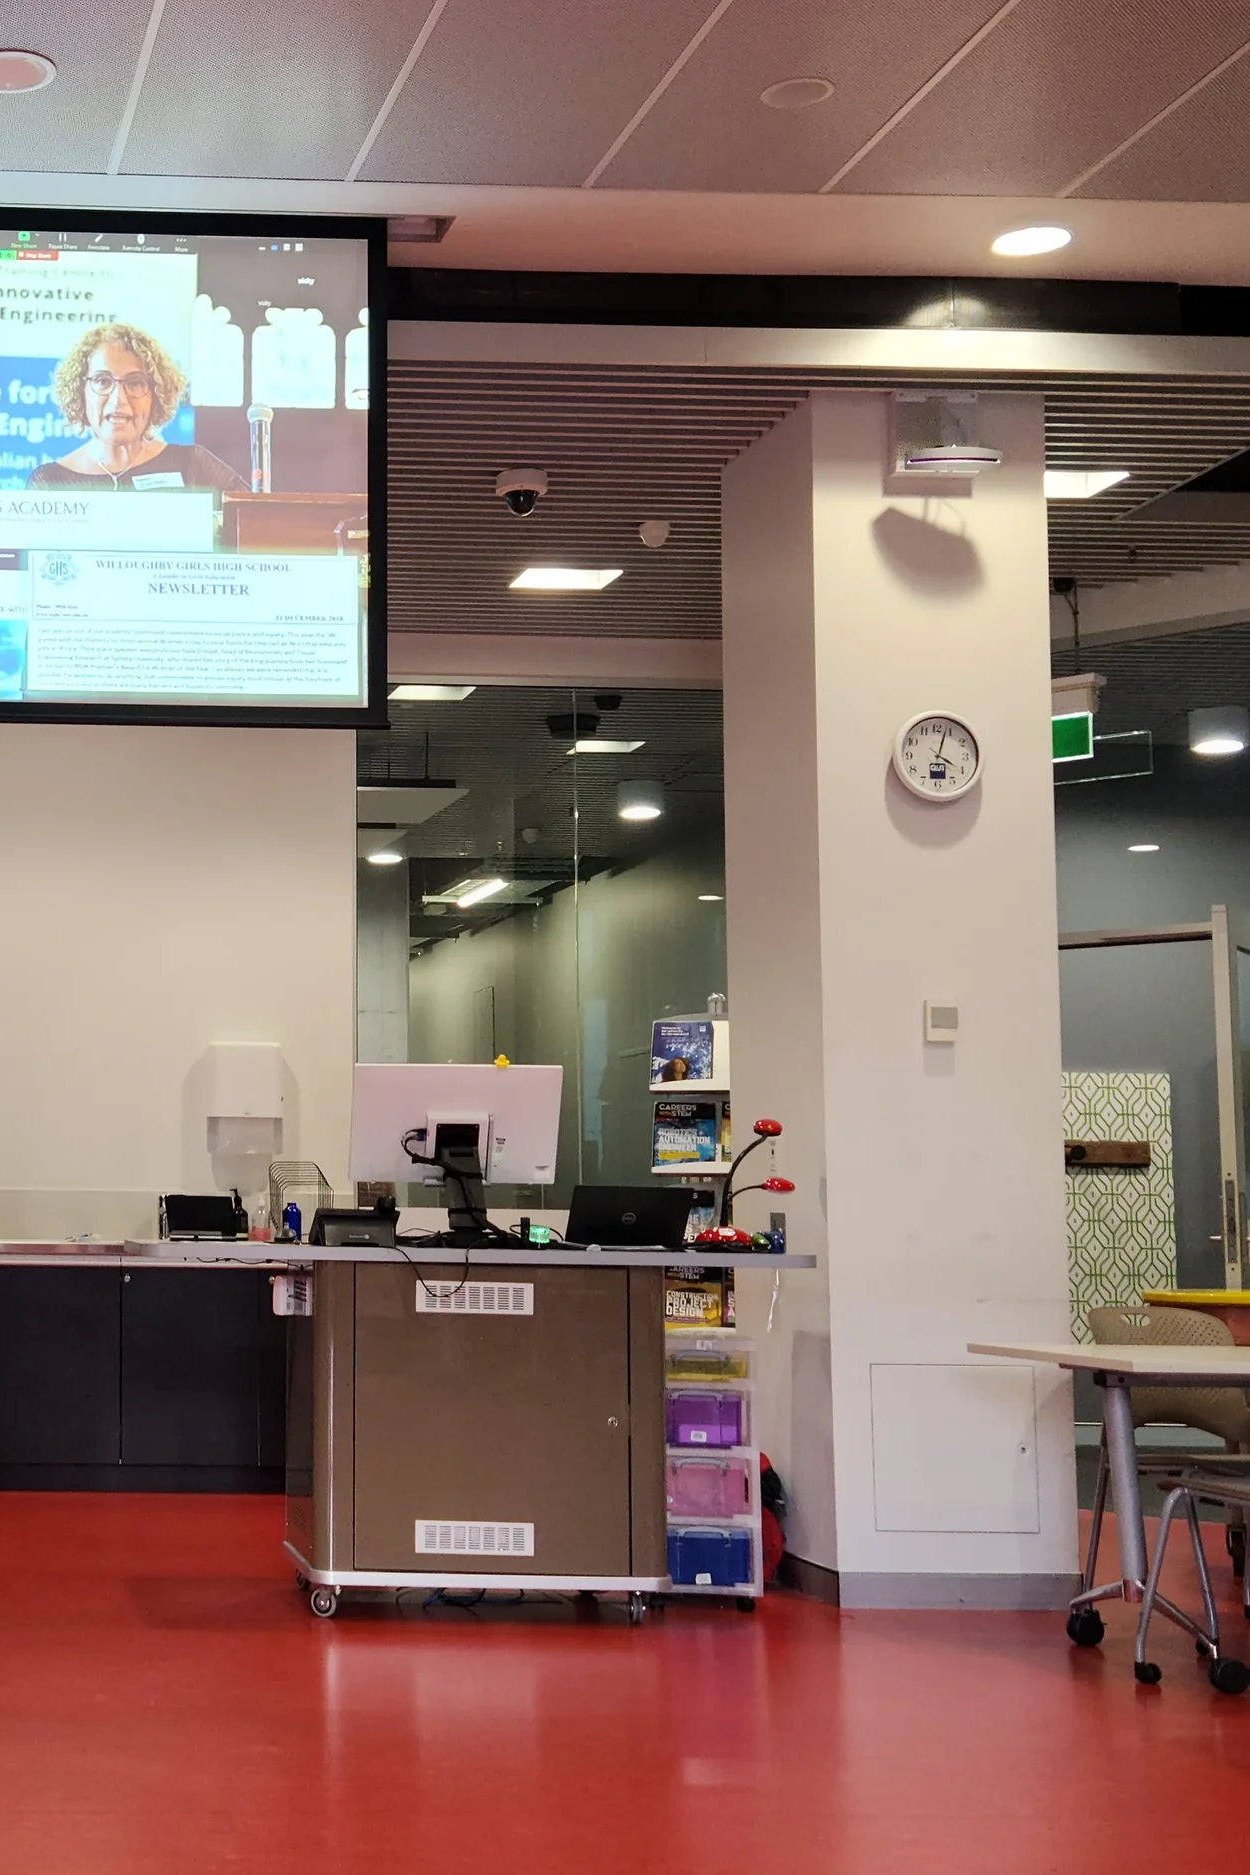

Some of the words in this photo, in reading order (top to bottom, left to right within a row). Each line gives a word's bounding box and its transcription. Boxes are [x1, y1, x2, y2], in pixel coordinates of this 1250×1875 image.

[8, 500, 90, 516] ACADEMY
[96, 560, 174, 571] WILLOUGHBY
[176, 561, 210, 571] GIRLS
[213, 562, 242, 572] HIGH
[245, 563, 292, 573] SCHOOL
[148, 582, 250, 597] NEWSLETTER
[920, 726, 928, 736] 11
[932, 724, 942, 733] 12
[908, 737, 918, 746] 10
[958, 738, 966, 748] 2
[905, 751, 913, 760] 9
[962, 752, 969, 761] 3
[909, 764, 917, 774] 8
[934, 780, 942, 788] 6
[949, 776, 956, 785] 5
[659, 1103, 697, 1111] CAREERS
[659, 1135, 710, 1144] AUTOMATION
[666, 1290, 718, 1300] CONSTRUCTION
[666, 1295, 713, 1309] PROJECT
[666, 1303, 704, 1317] DESIGN
